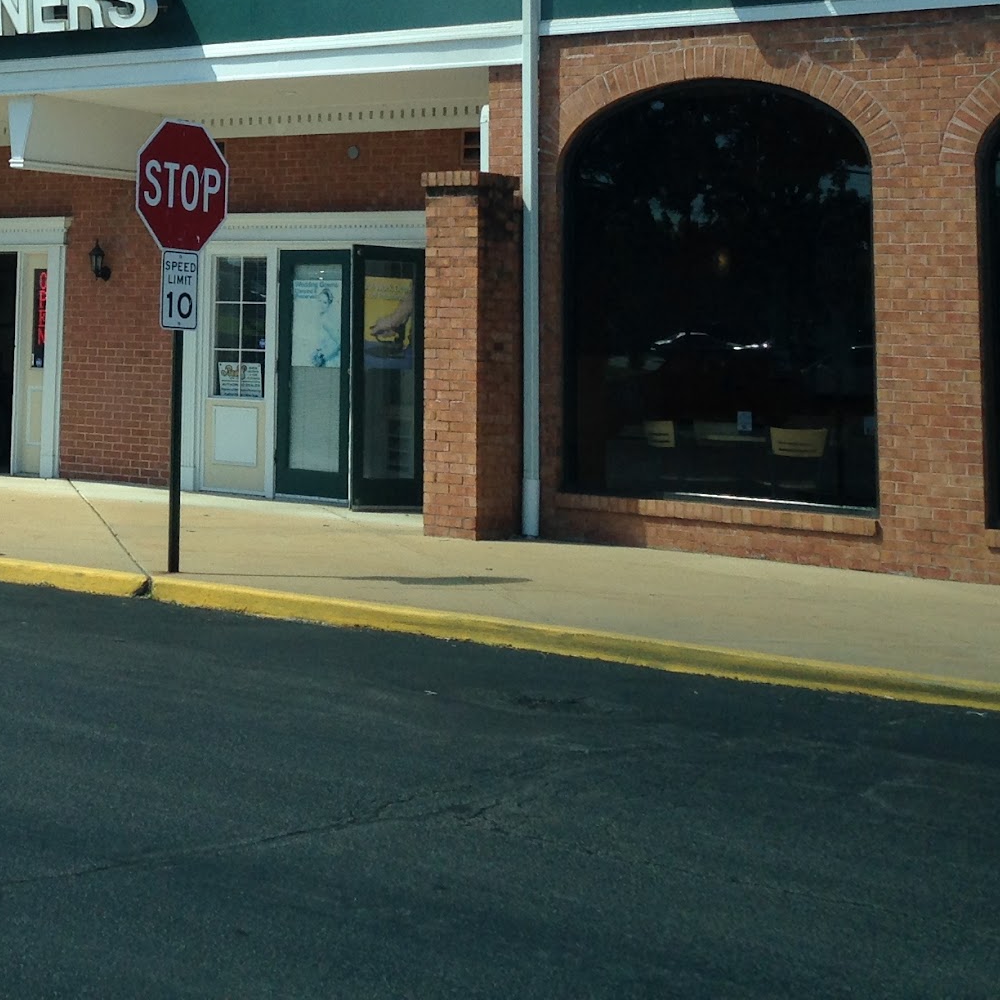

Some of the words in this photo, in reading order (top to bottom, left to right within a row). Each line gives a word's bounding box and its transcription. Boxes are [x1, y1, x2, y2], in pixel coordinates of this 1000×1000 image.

[143, 159, 221, 213] STOP
[164, 260, 197, 273] SPEED
[167, 275, 193, 287] LIMIT
[37, 271, 47, 345] OPEN
[166, 291, 193, 320] 10
